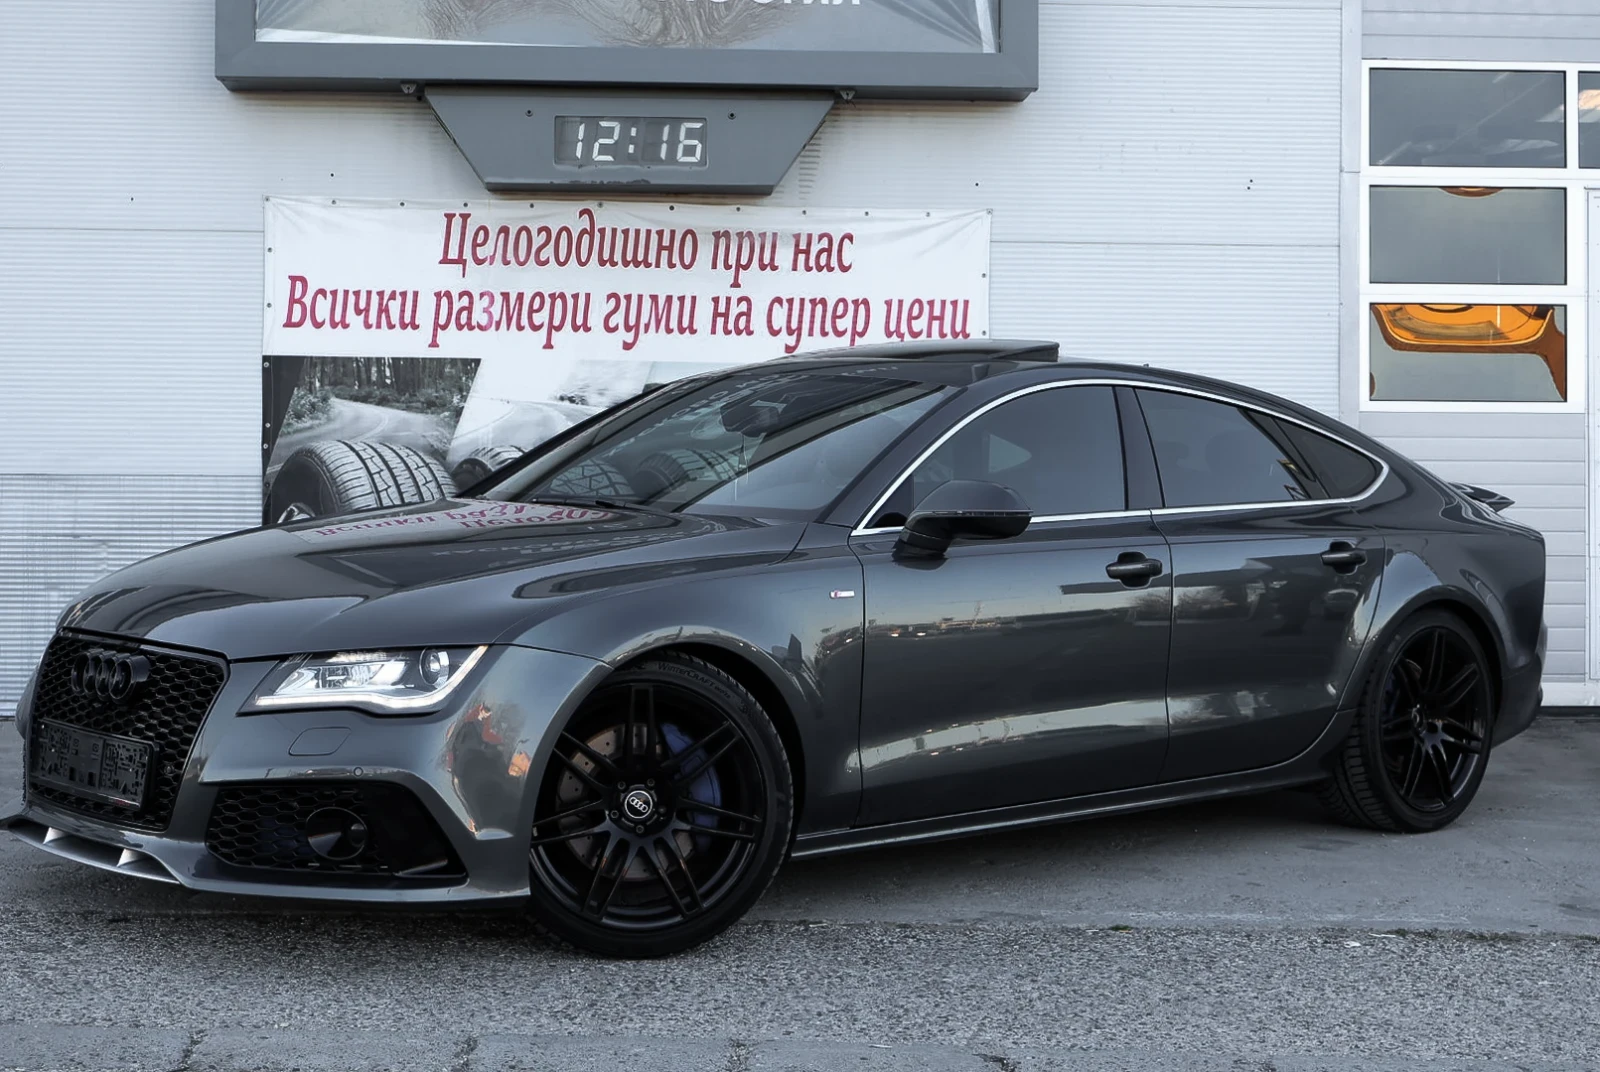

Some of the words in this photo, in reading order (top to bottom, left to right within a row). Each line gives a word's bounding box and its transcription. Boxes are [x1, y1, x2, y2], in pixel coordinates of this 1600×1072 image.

[576, 121, 703, 162] 12:16
[439, 208, 698, 278] Целогодишно
[711, 227, 779, 288] при
[791, 232, 854, 273] нас
[283, 275, 420, 330] Всички
[428, 289, 592, 349] размери
[603, 292, 698, 350] гуми
[711, 295, 754, 336] на
[766, 296, 870, 354] супер
[884, 298, 971, 342] цени
